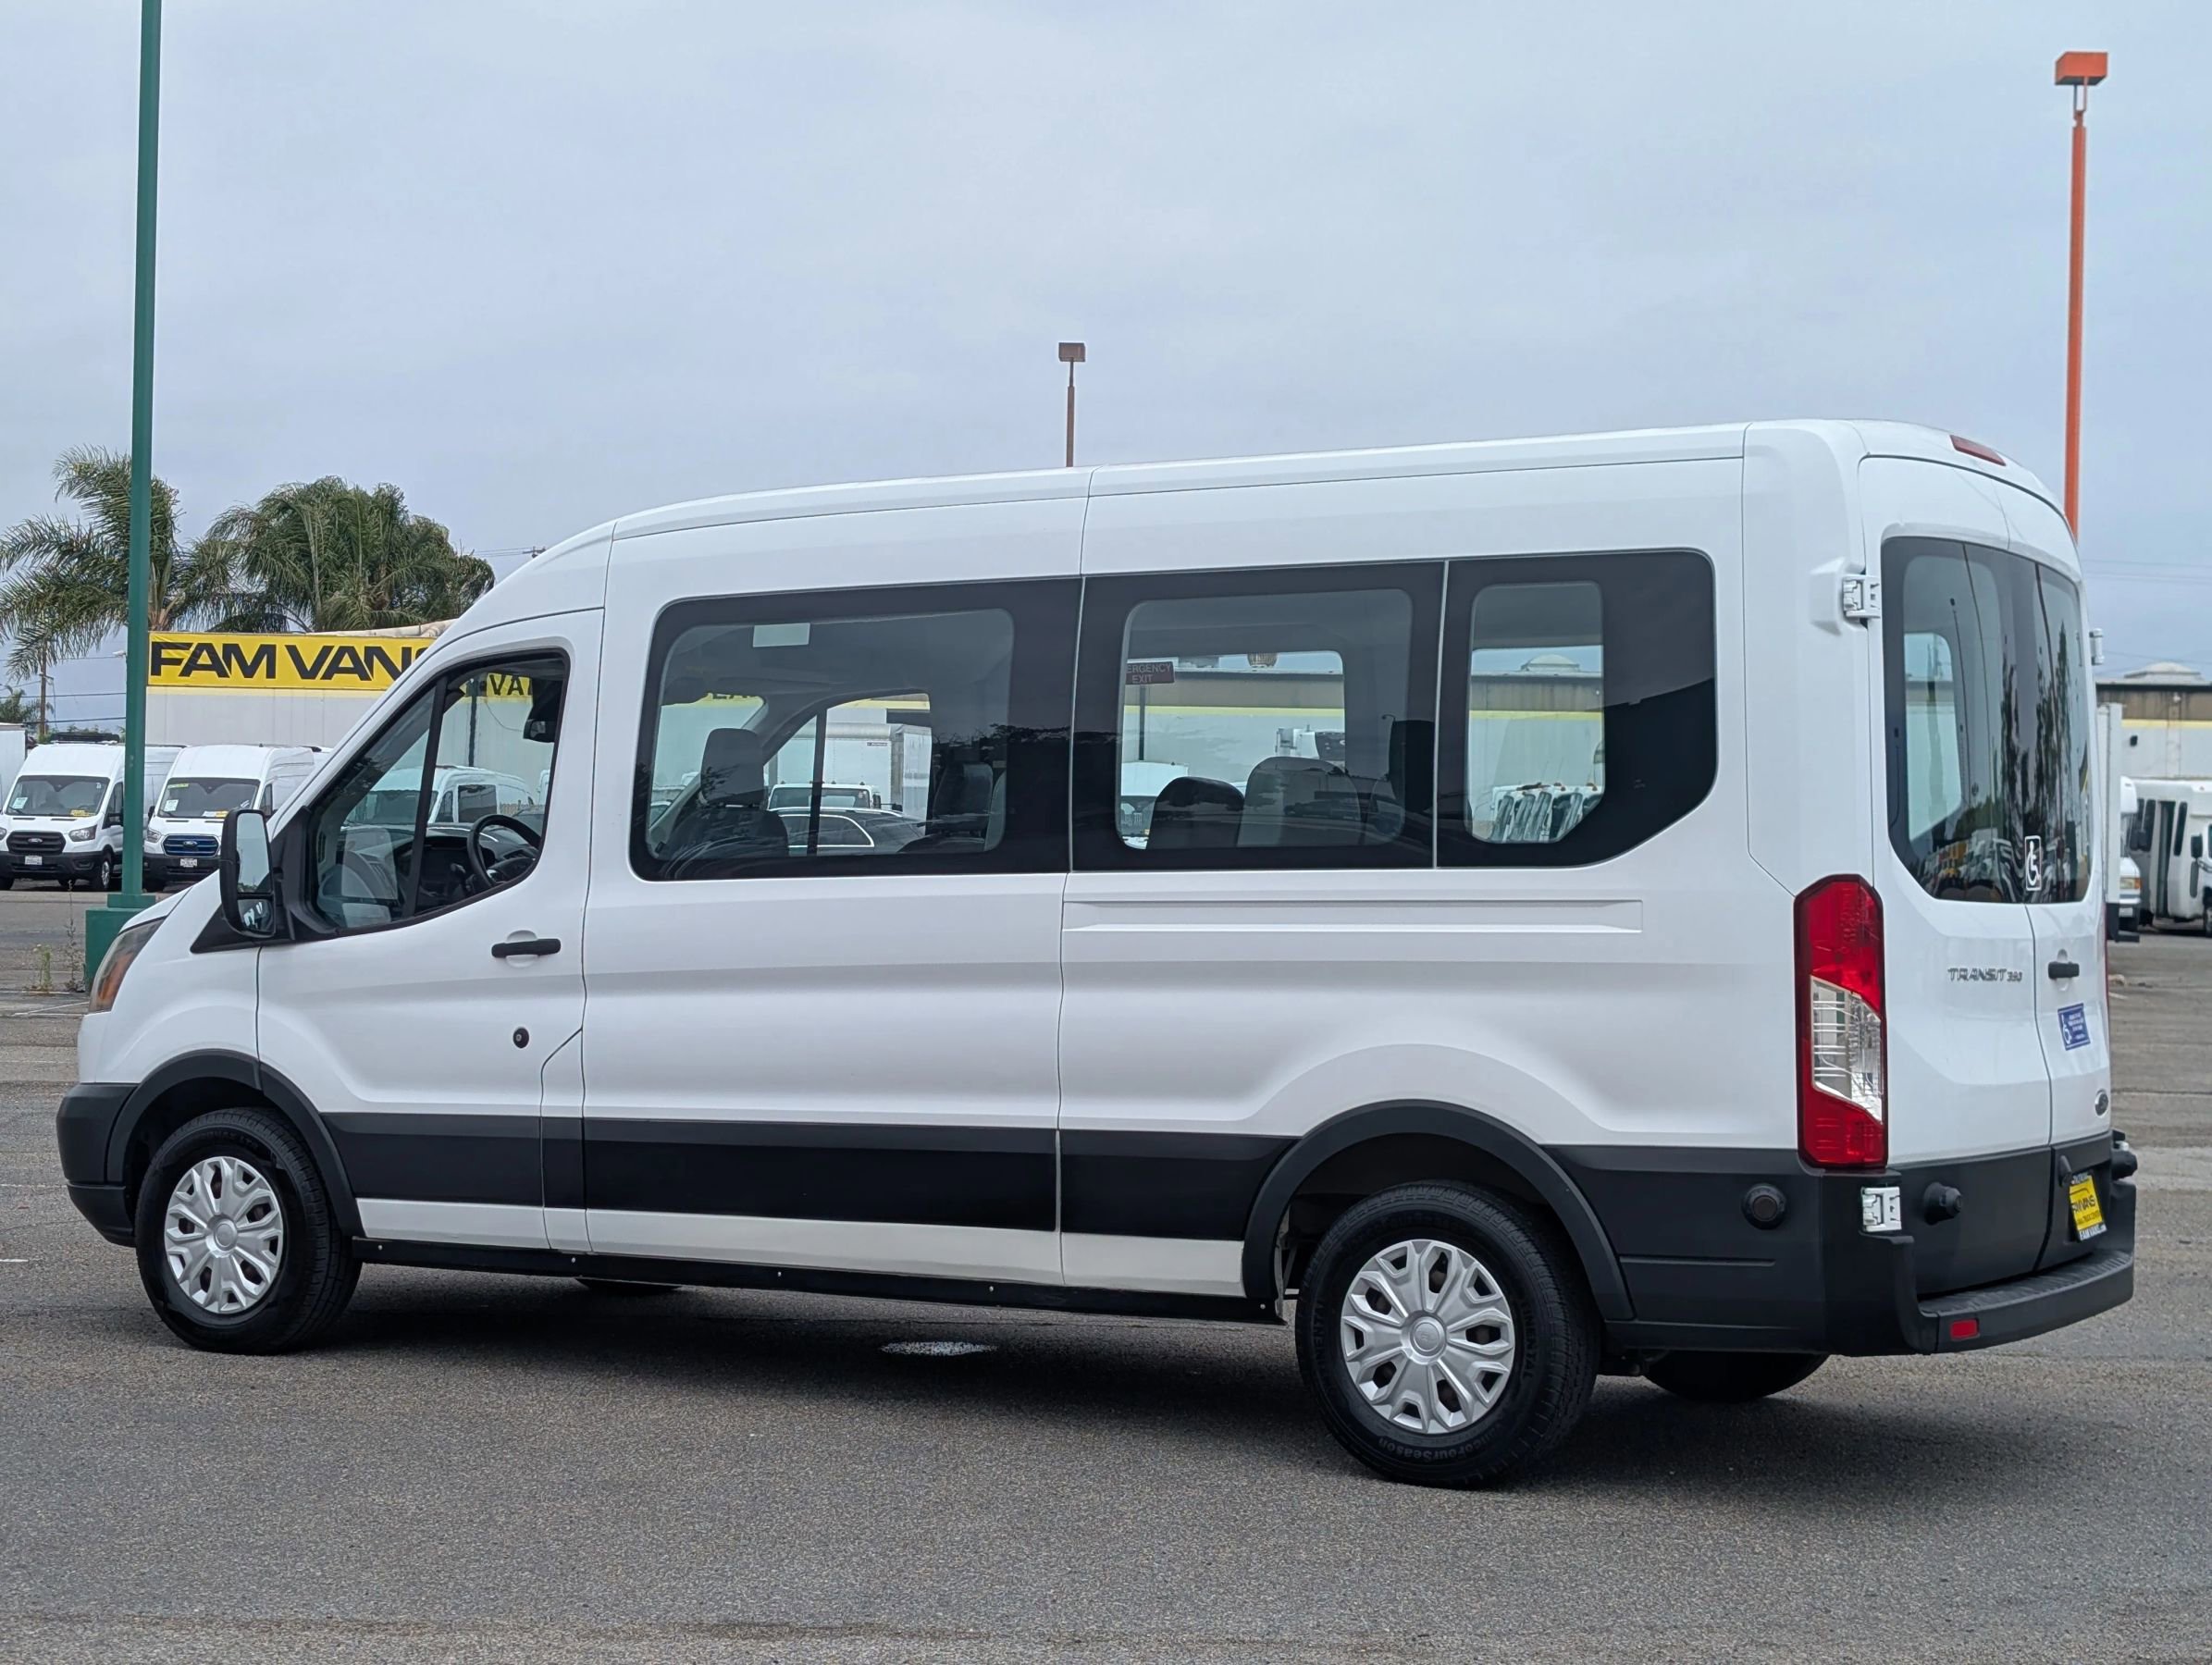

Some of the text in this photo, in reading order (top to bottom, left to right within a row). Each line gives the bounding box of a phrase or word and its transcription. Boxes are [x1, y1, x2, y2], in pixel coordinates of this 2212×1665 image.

[150, 641, 427, 681] FAM VAN
[1131, 673, 1153, 684] EXIT
[1947, 968, 2007, 981] TRANSIT
